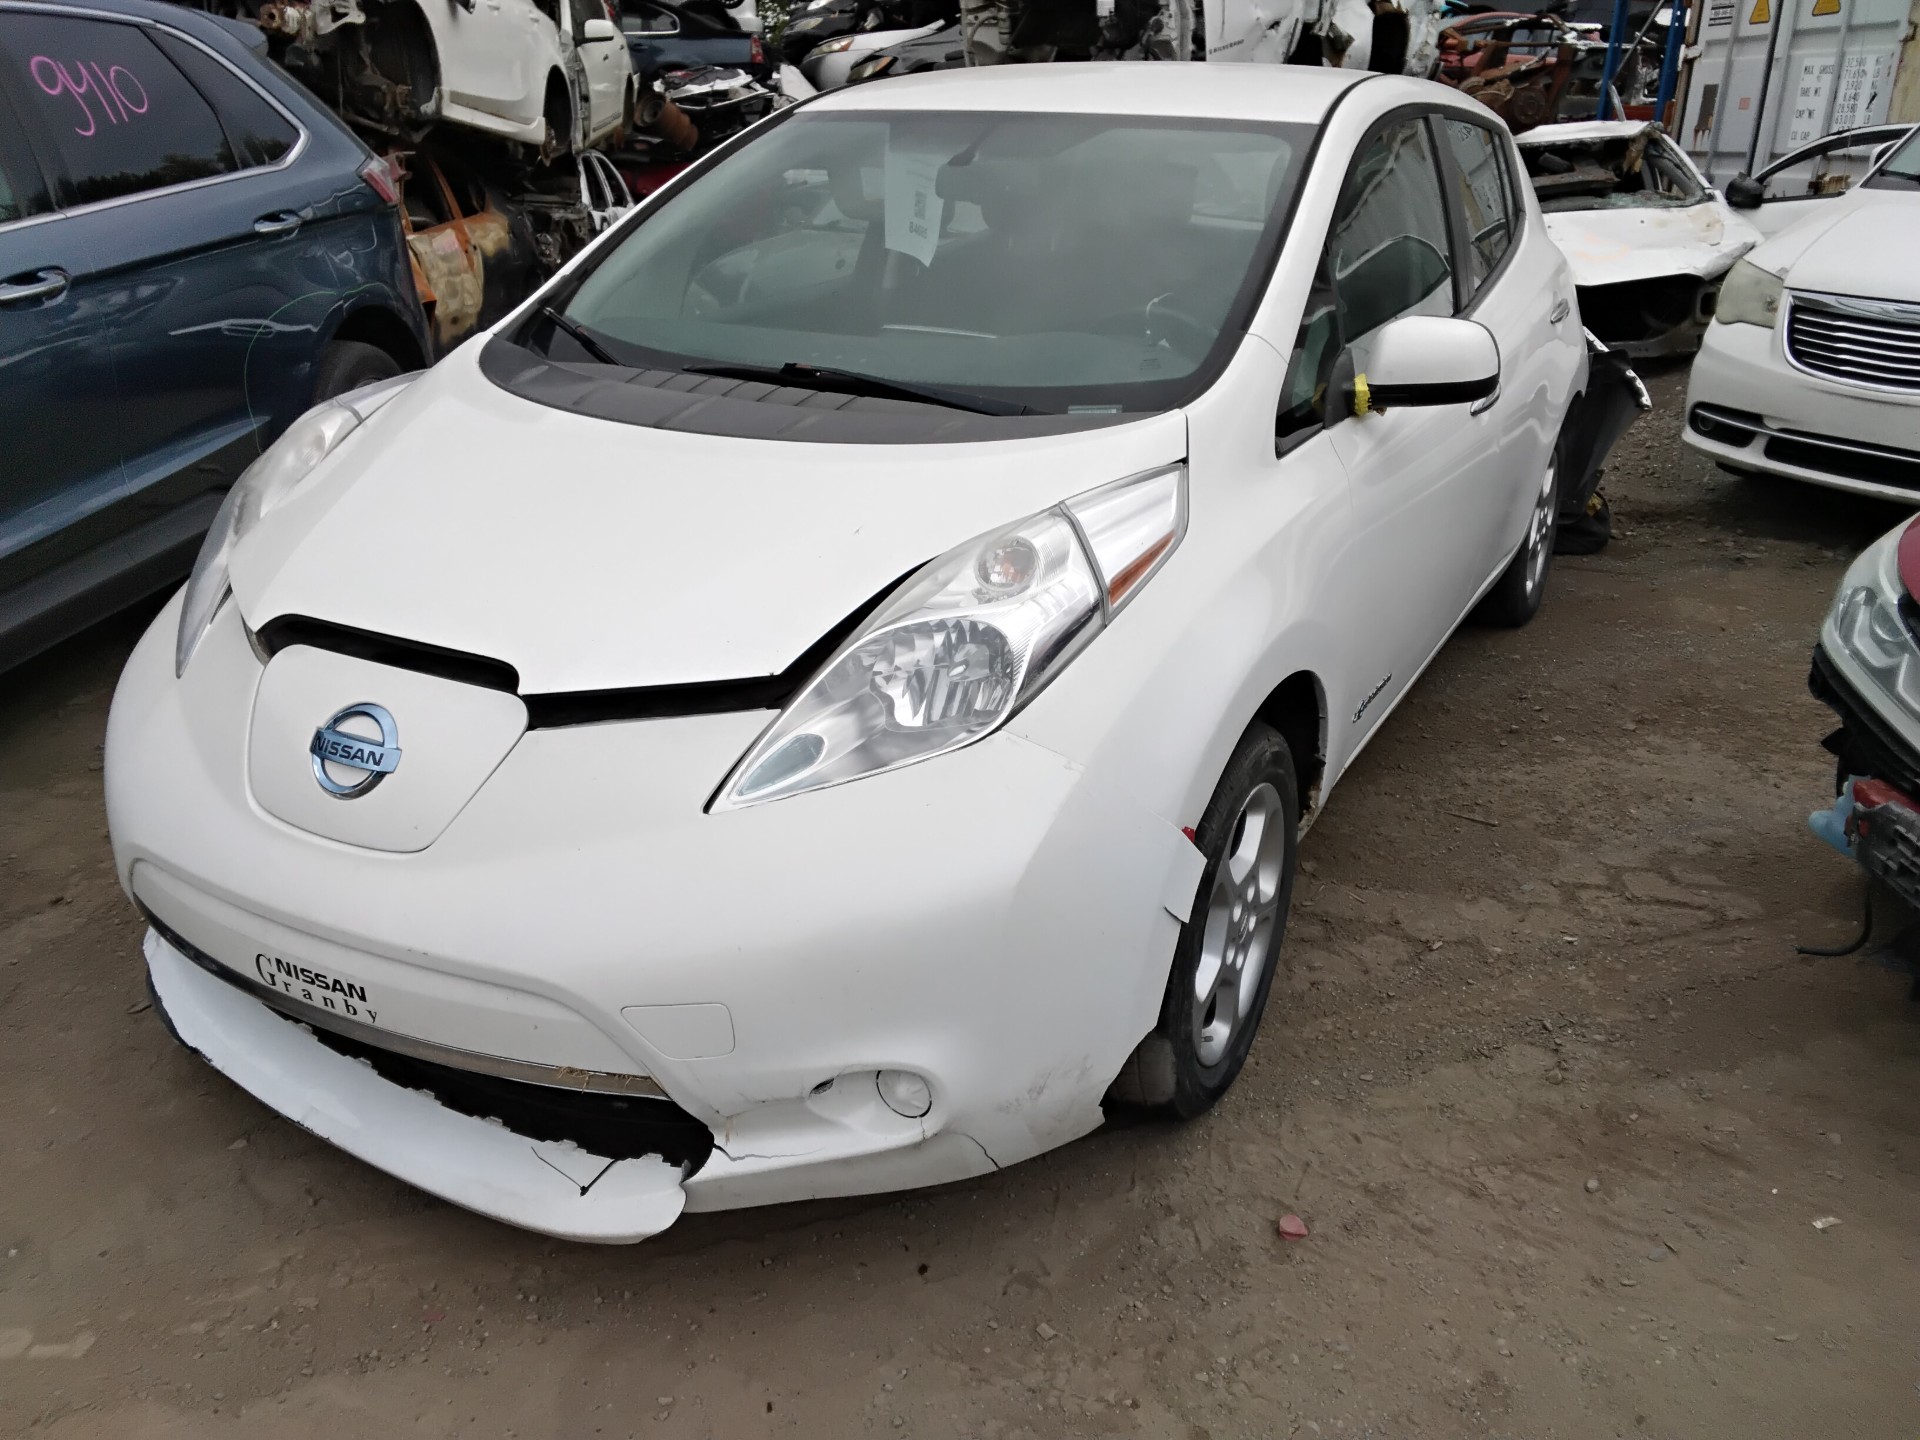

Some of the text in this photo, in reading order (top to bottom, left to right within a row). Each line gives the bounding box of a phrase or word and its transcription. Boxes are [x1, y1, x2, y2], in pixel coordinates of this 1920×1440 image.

[30, 55, 148, 136] 9410
[313, 736, 385, 767] NISSAN
[255, 953, 378, 1024] Granby
[275, 957, 368, 1003] NISSAN
